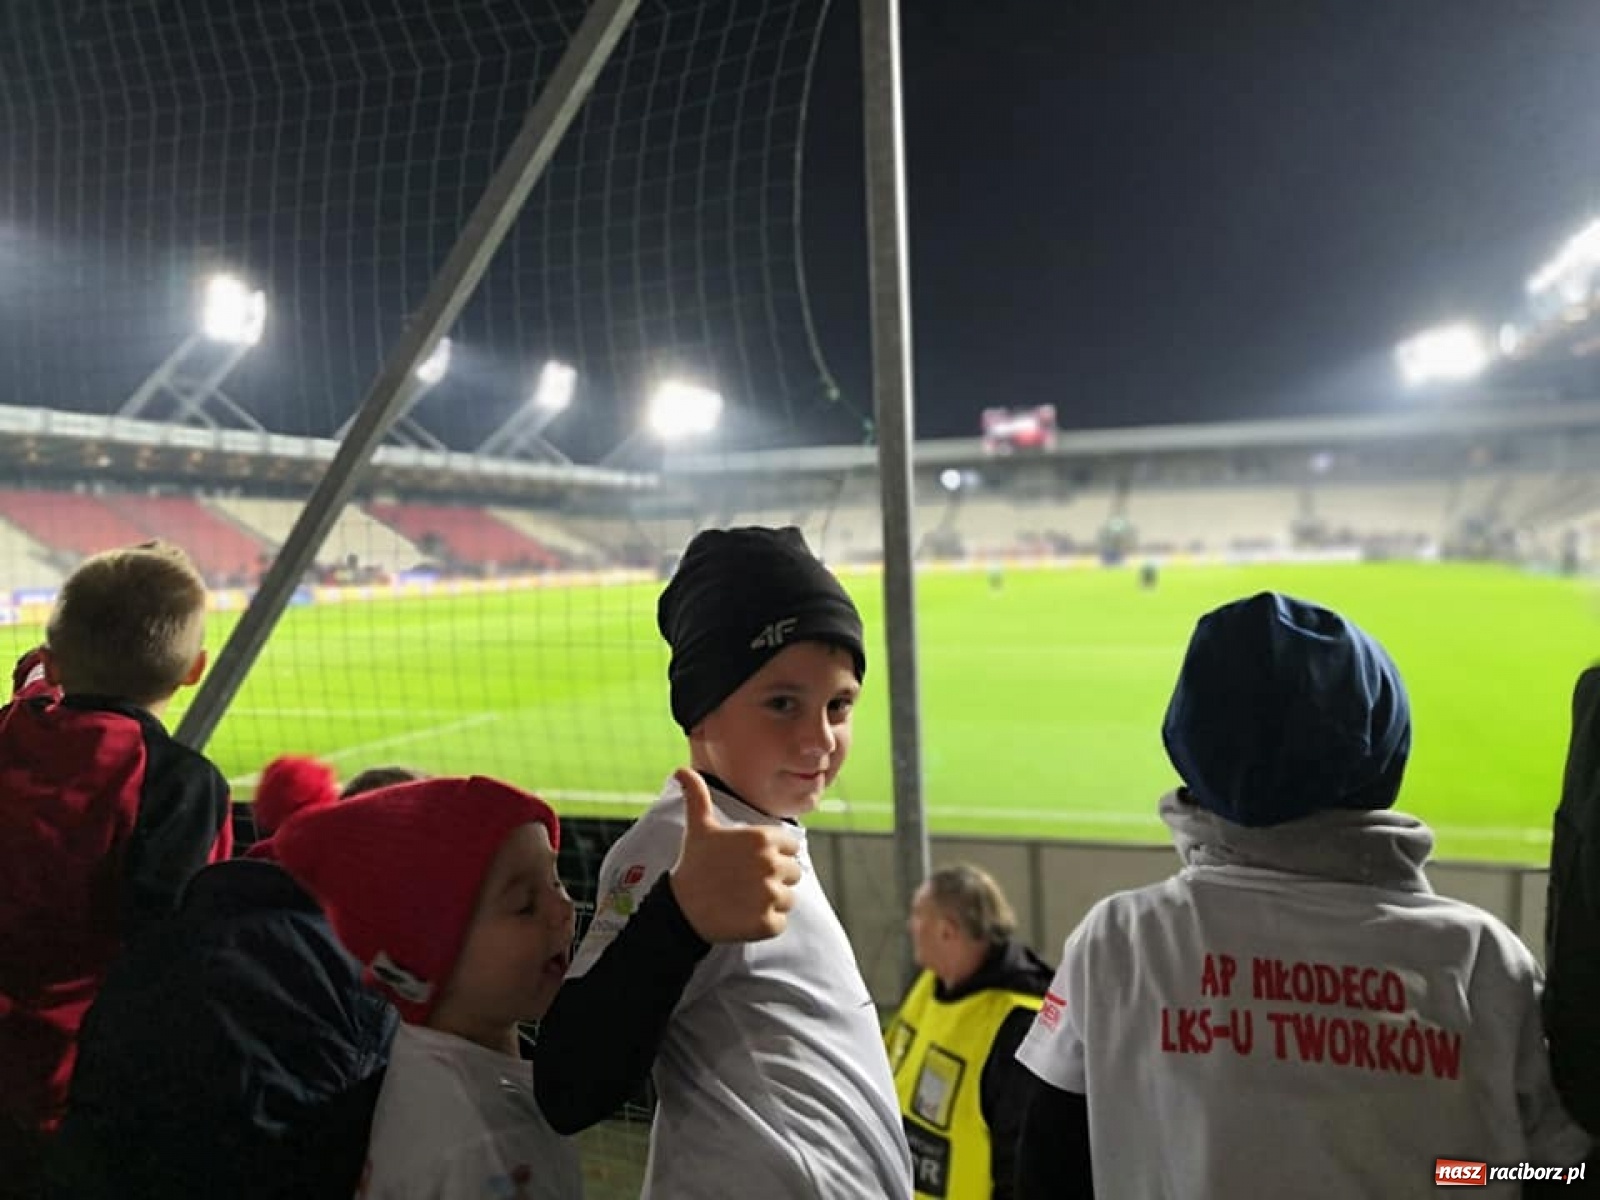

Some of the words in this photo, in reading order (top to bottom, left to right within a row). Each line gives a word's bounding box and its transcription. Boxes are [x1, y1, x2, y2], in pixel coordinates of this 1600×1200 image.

[1202, 953, 1236, 998] AP
[1253, 957, 1406, 1014] MŁODEGO
[1161, 1007, 1253, 1055] LKS-U
[1266, 1012, 1461, 1080] TWORKÓW
